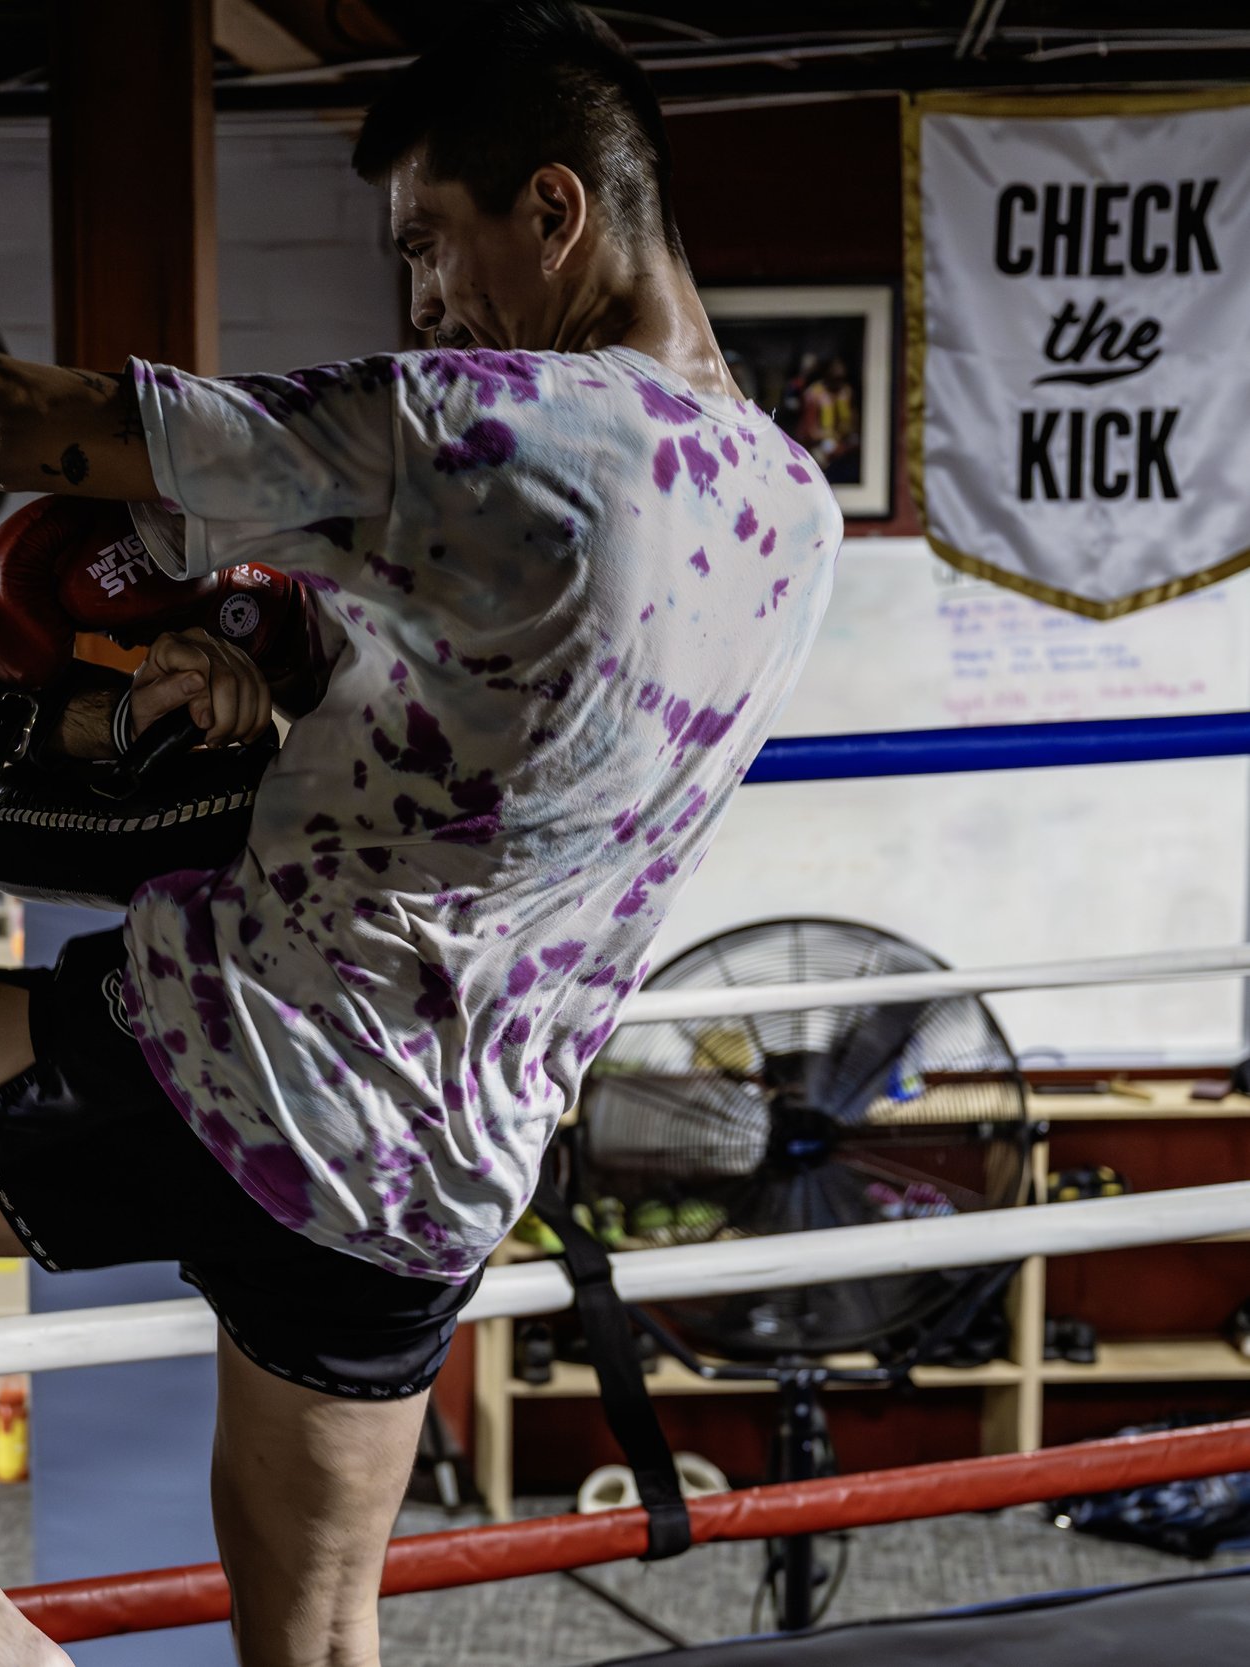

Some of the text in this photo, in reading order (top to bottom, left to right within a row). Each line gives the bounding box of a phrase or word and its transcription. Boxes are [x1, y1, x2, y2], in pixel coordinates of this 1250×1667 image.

[995, 179, 1220, 276] CHECK
[1042, 299, 1162, 372] the
[1019, 408, 1180, 500] KICK
[85, 533, 146, 581] INFIG
[99, 551, 154, 599] STY
